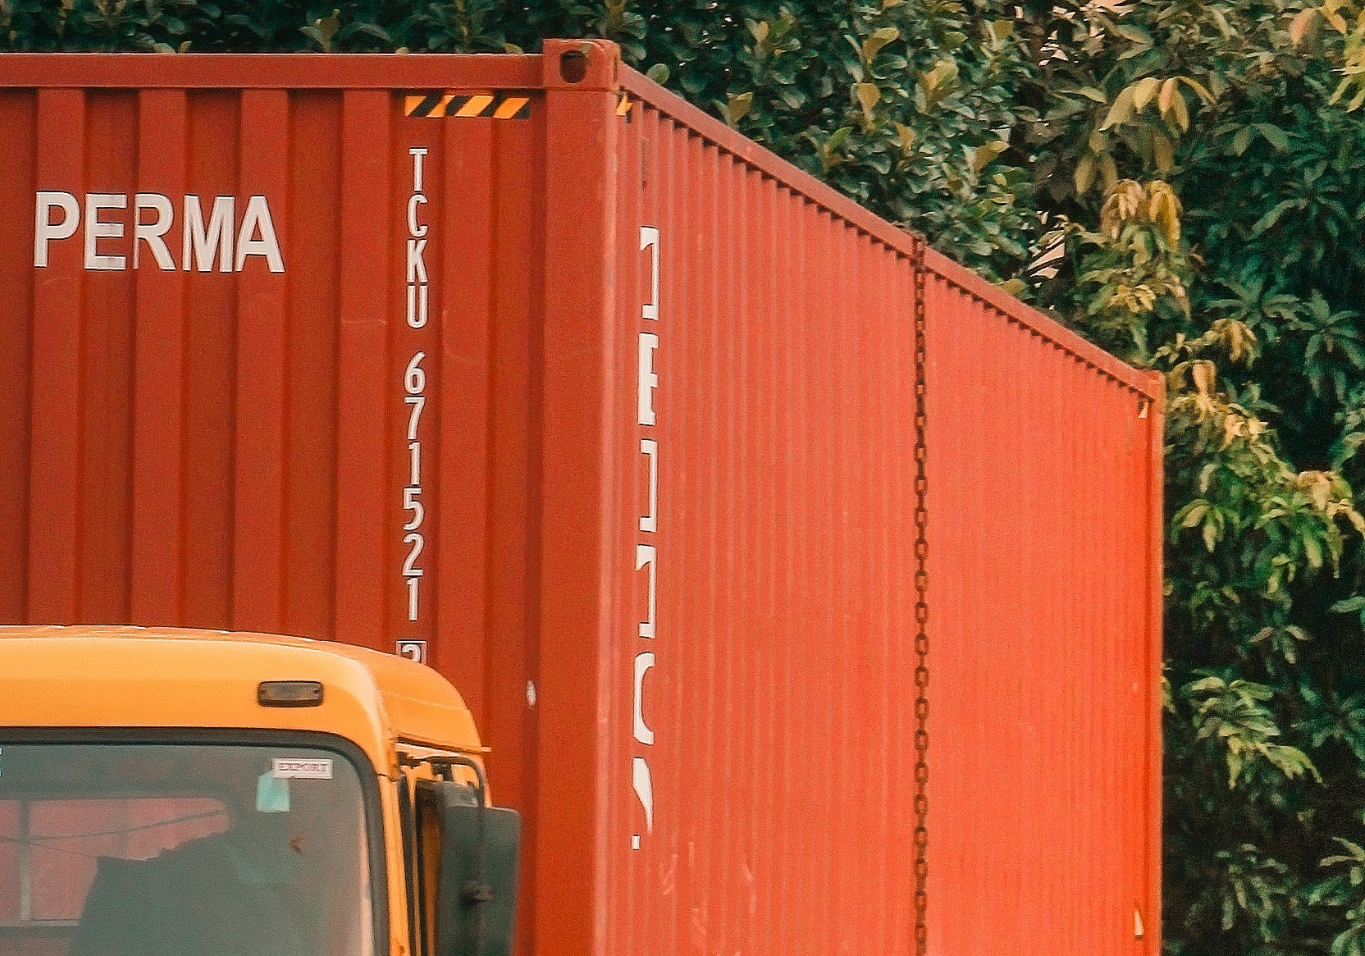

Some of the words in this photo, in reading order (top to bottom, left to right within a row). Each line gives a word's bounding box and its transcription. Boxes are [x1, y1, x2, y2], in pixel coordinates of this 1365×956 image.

[33, 190, 286, 274] PERMA
[407, 148, 430, 328] TCKU
[402, 352, 426, 621] 671521
